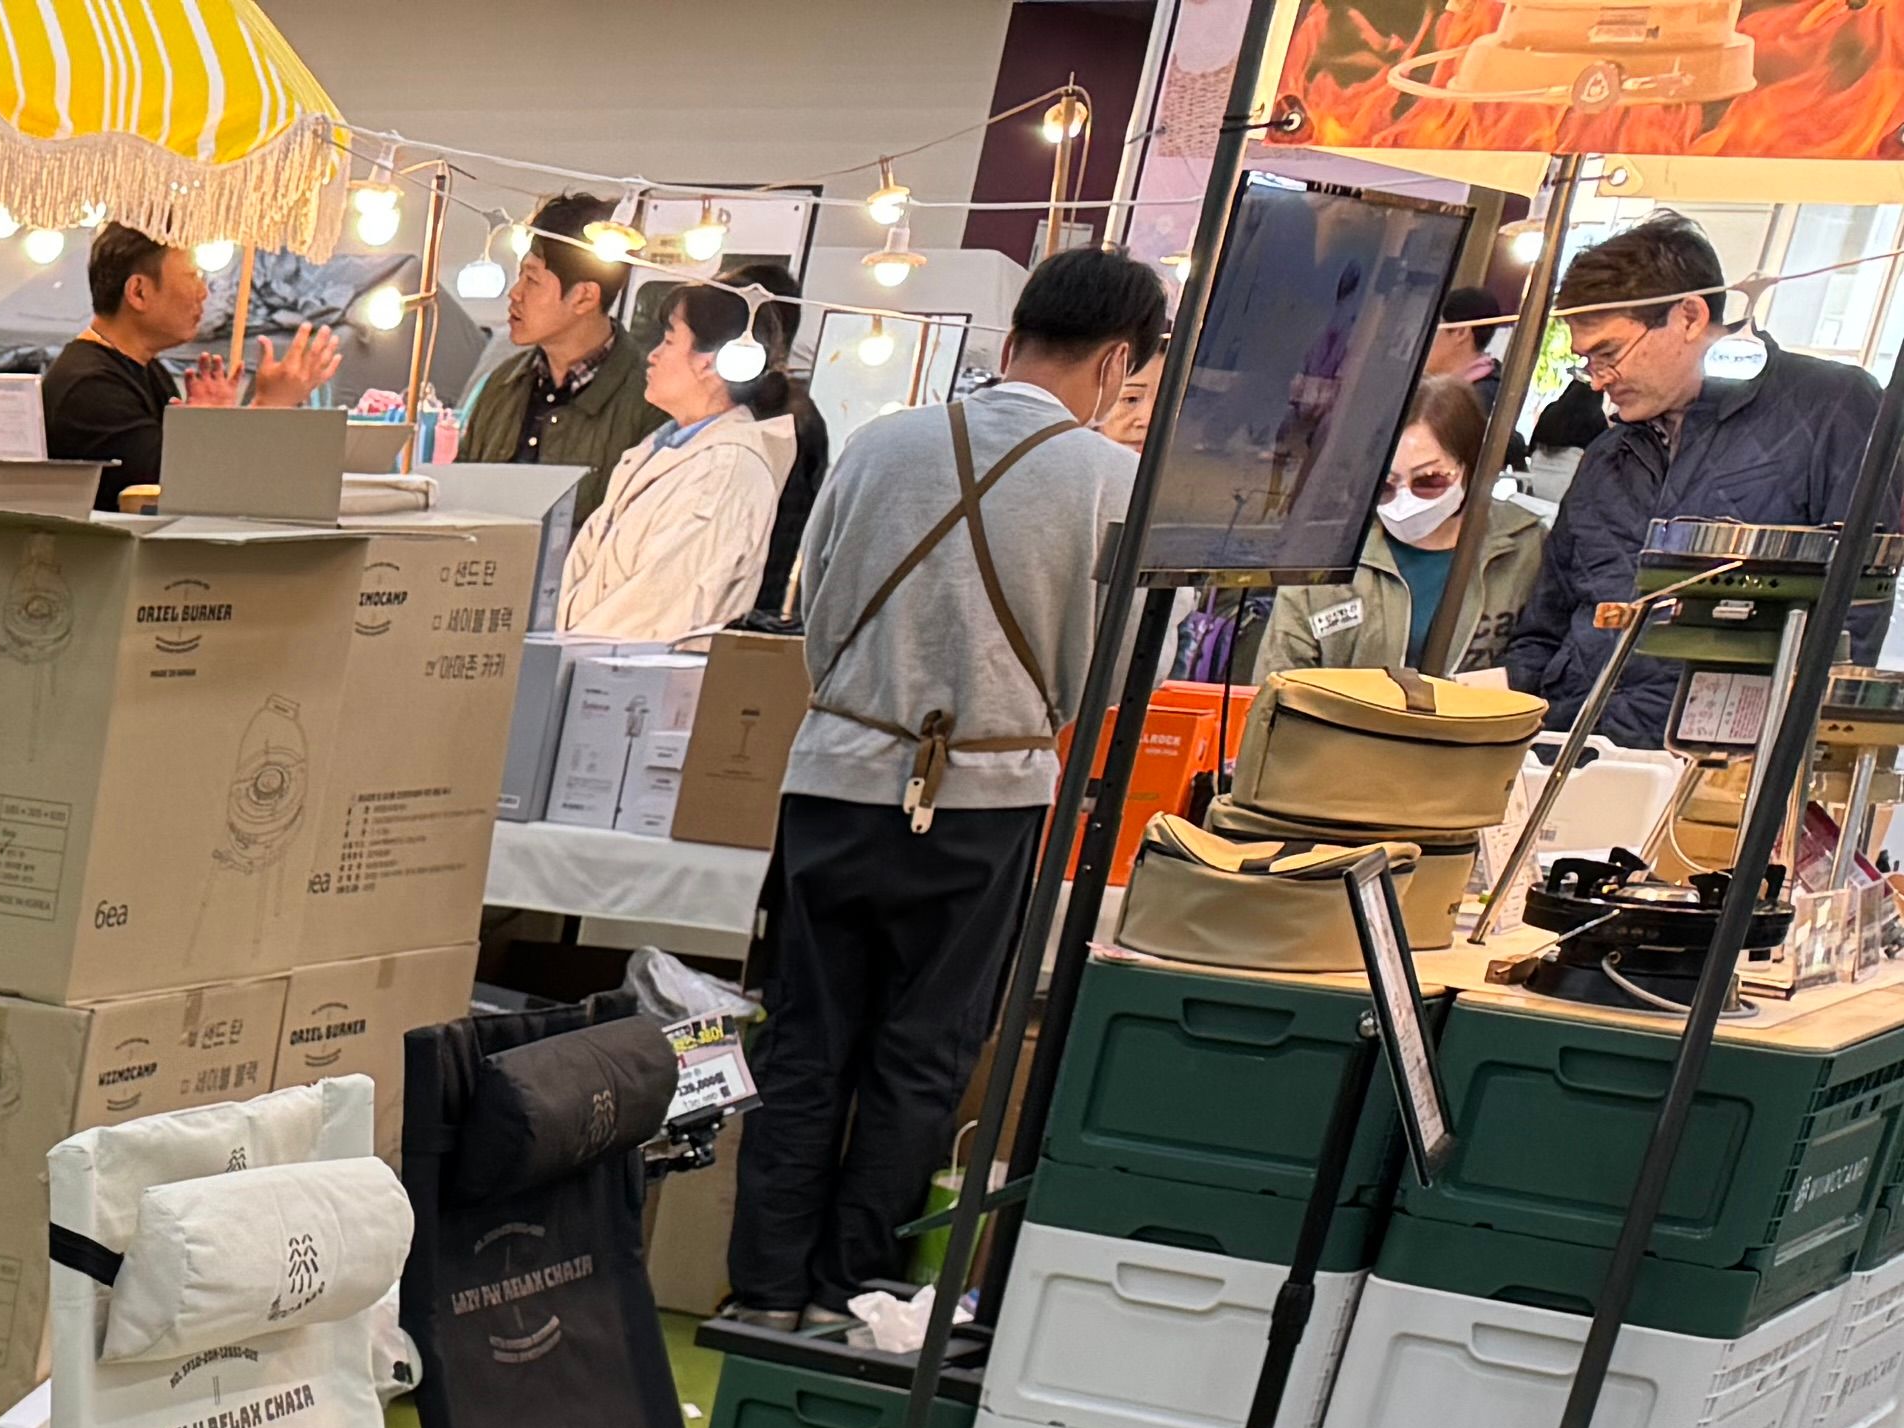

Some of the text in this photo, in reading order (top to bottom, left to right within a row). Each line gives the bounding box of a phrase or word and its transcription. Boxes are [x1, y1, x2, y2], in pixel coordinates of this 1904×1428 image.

[455, 561, 480, 586] 샌드
[359, 591, 408, 606] IMOCAMP
[137, 604, 232, 623] ORIEL BURNER
[447, 607, 513, 633] 세이블 블랙
[439, 653, 506, 680] 아마존 카키
[307, 872, 331, 893] ea
[95, 900, 128, 929] 6ea
[98, 1062, 157, 1086] WIIMOCAMP
[544, 1254, 593, 1288] CHAIR
[264, 1384, 315, 1421] CHAIR
